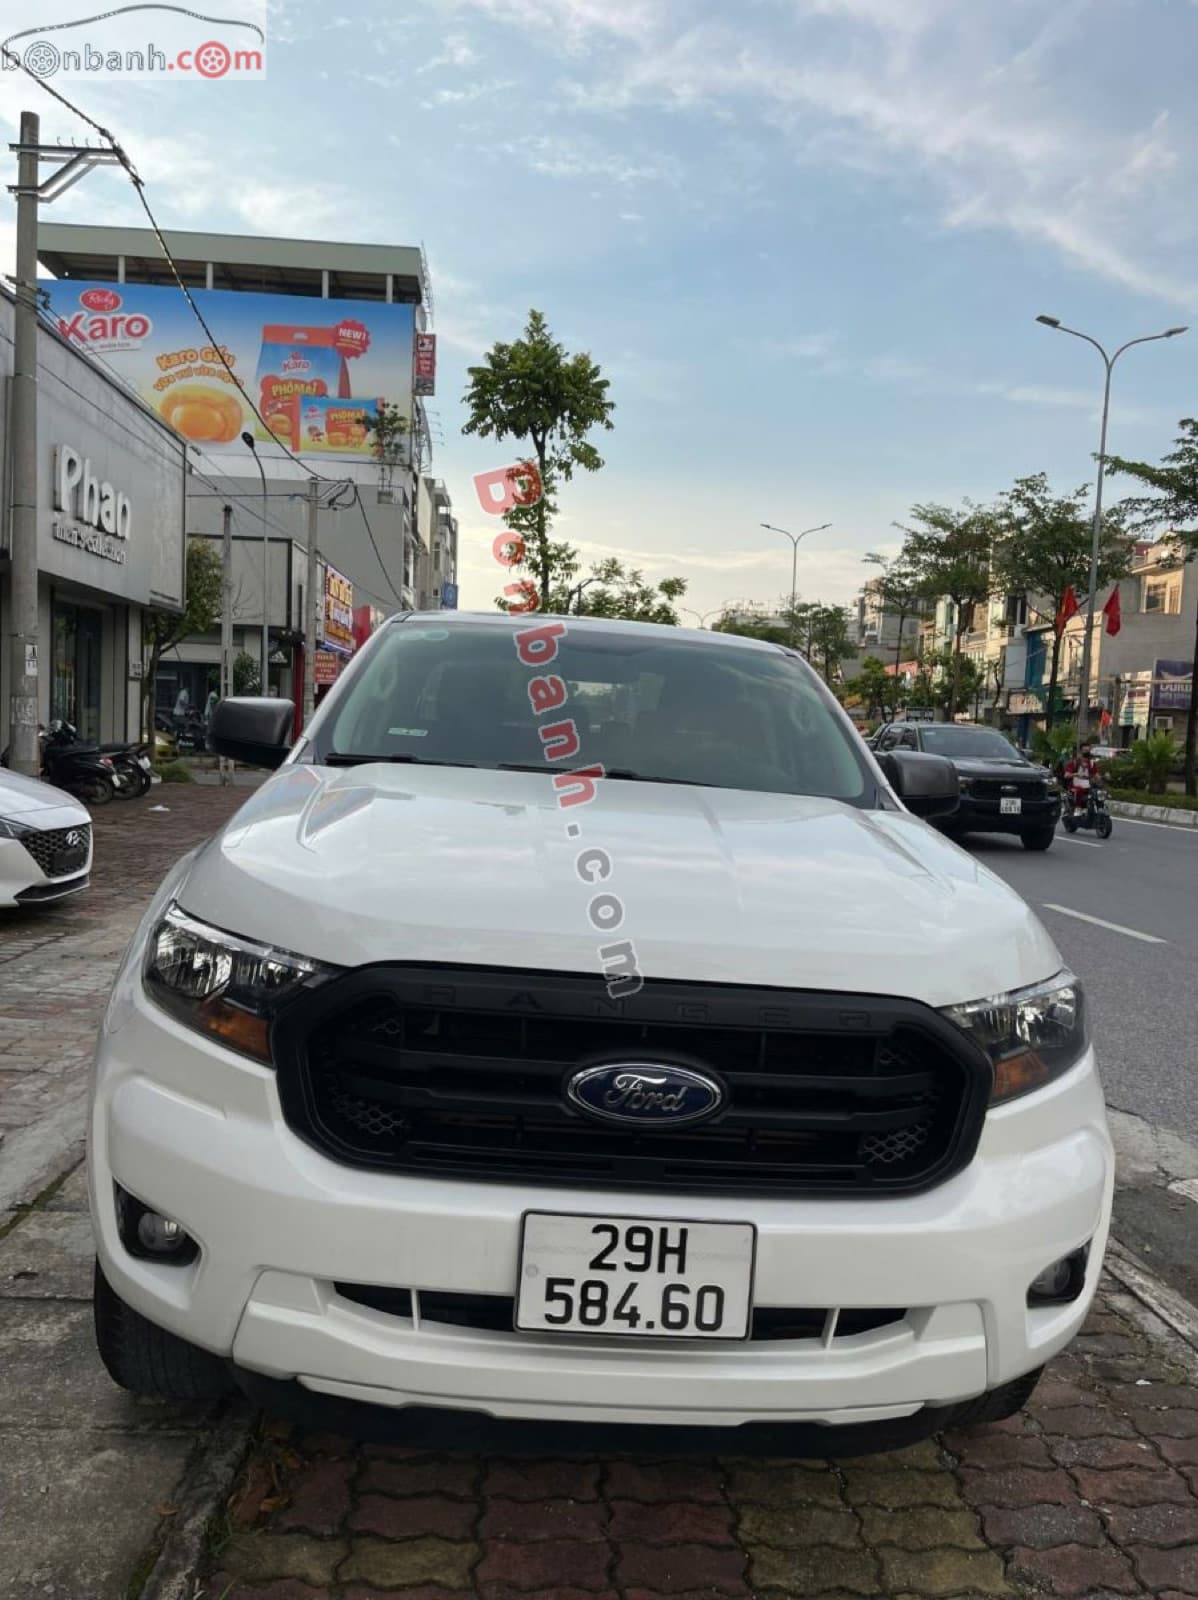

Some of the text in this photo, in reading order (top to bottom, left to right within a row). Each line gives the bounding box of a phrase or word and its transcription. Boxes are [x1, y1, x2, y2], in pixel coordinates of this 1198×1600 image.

[57, 312, 151, 343] Karo
[156, 348, 198, 371] Karo
[54, 444, 131, 540] Phan
[422, 983, 872, 1028] RANGER
[604, 1074, 688, 1112] Ford
[589, 1223, 688, 1275] 29H
[544, 1277, 725, 1332] 584.60
